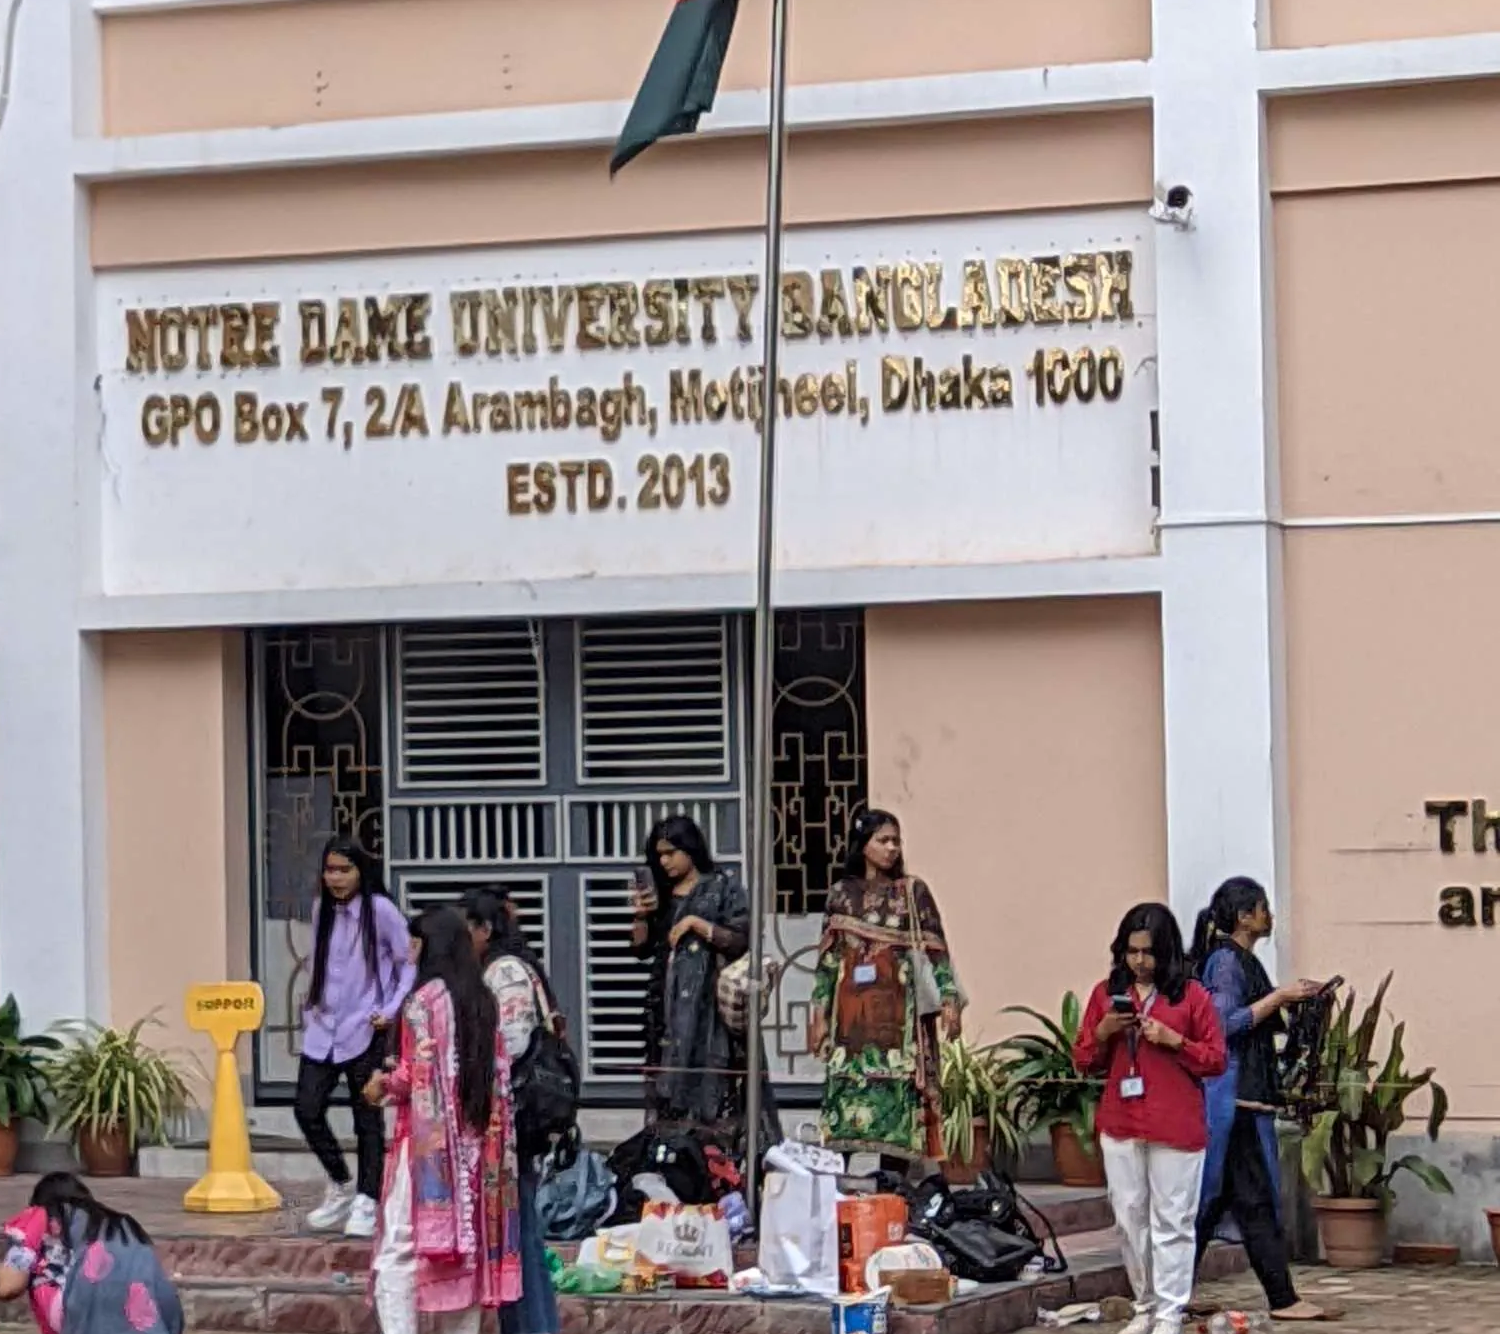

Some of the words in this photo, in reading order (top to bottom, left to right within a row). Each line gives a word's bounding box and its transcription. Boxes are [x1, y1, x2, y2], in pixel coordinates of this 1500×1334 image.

[125, 303, 282, 372] NOTRE
[298, 292, 434, 366] DAME
[449, 274, 760, 356] UNIVERSITY
[781, 250, 1135, 338] BANGLADESH
[141, 390, 222, 448] GPO
[233, 389, 311, 444] Box
[321, 386, 355, 451] 7,
[364, 382, 430, 440] 2/A
[441, 368, 659, 443] Arambagh,
[881, 354, 1014, 413] Dhaka
[1025, 345, 1125, 408] 1000
[506, 459, 627, 518] ESTD.
[637, 452, 732, 510] 2013
